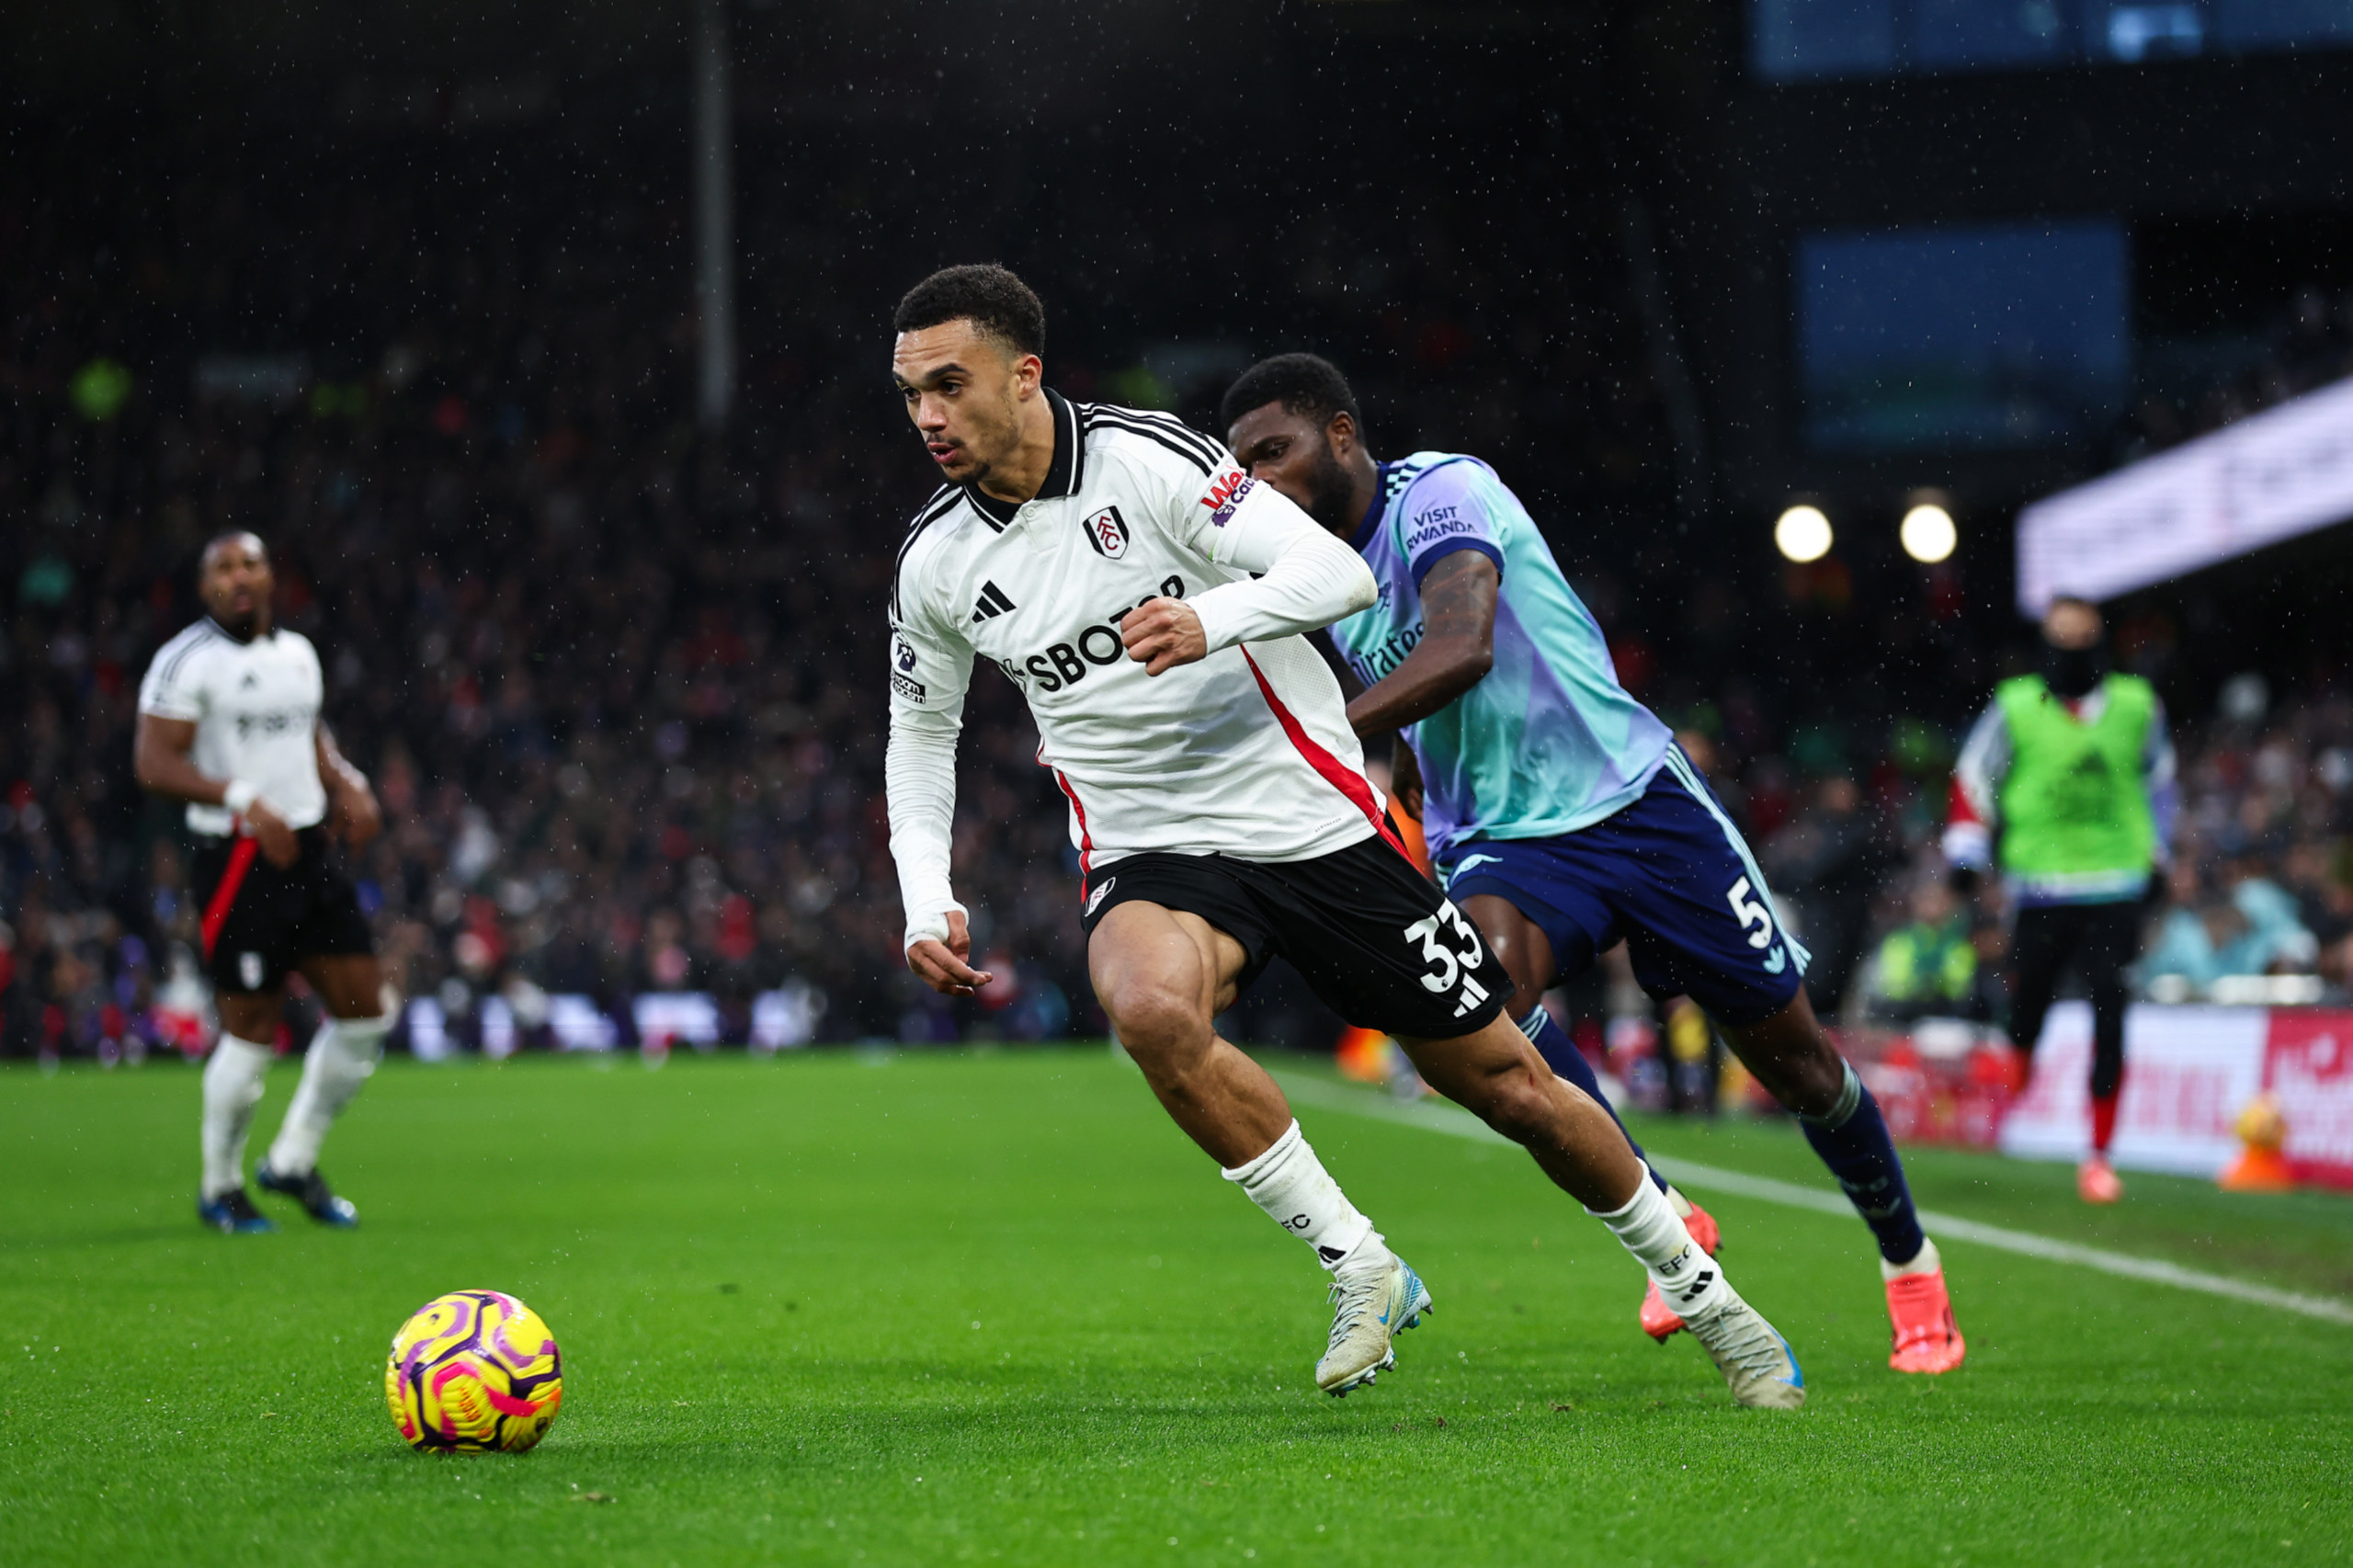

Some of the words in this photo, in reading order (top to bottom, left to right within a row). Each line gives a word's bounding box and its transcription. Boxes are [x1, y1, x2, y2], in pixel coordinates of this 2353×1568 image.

[1200, 463, 1245, 511] We
[1097, 515, 1120, 551] FFC
[1406, 520, 1478, 552] RWANDA
[1414, 506, 1458, 527] VISIT
[1025, 574, 1186, 693] SBOP
[1726, 875, 1772, 949] 5
[1404, 897, 1483, 993] 33
